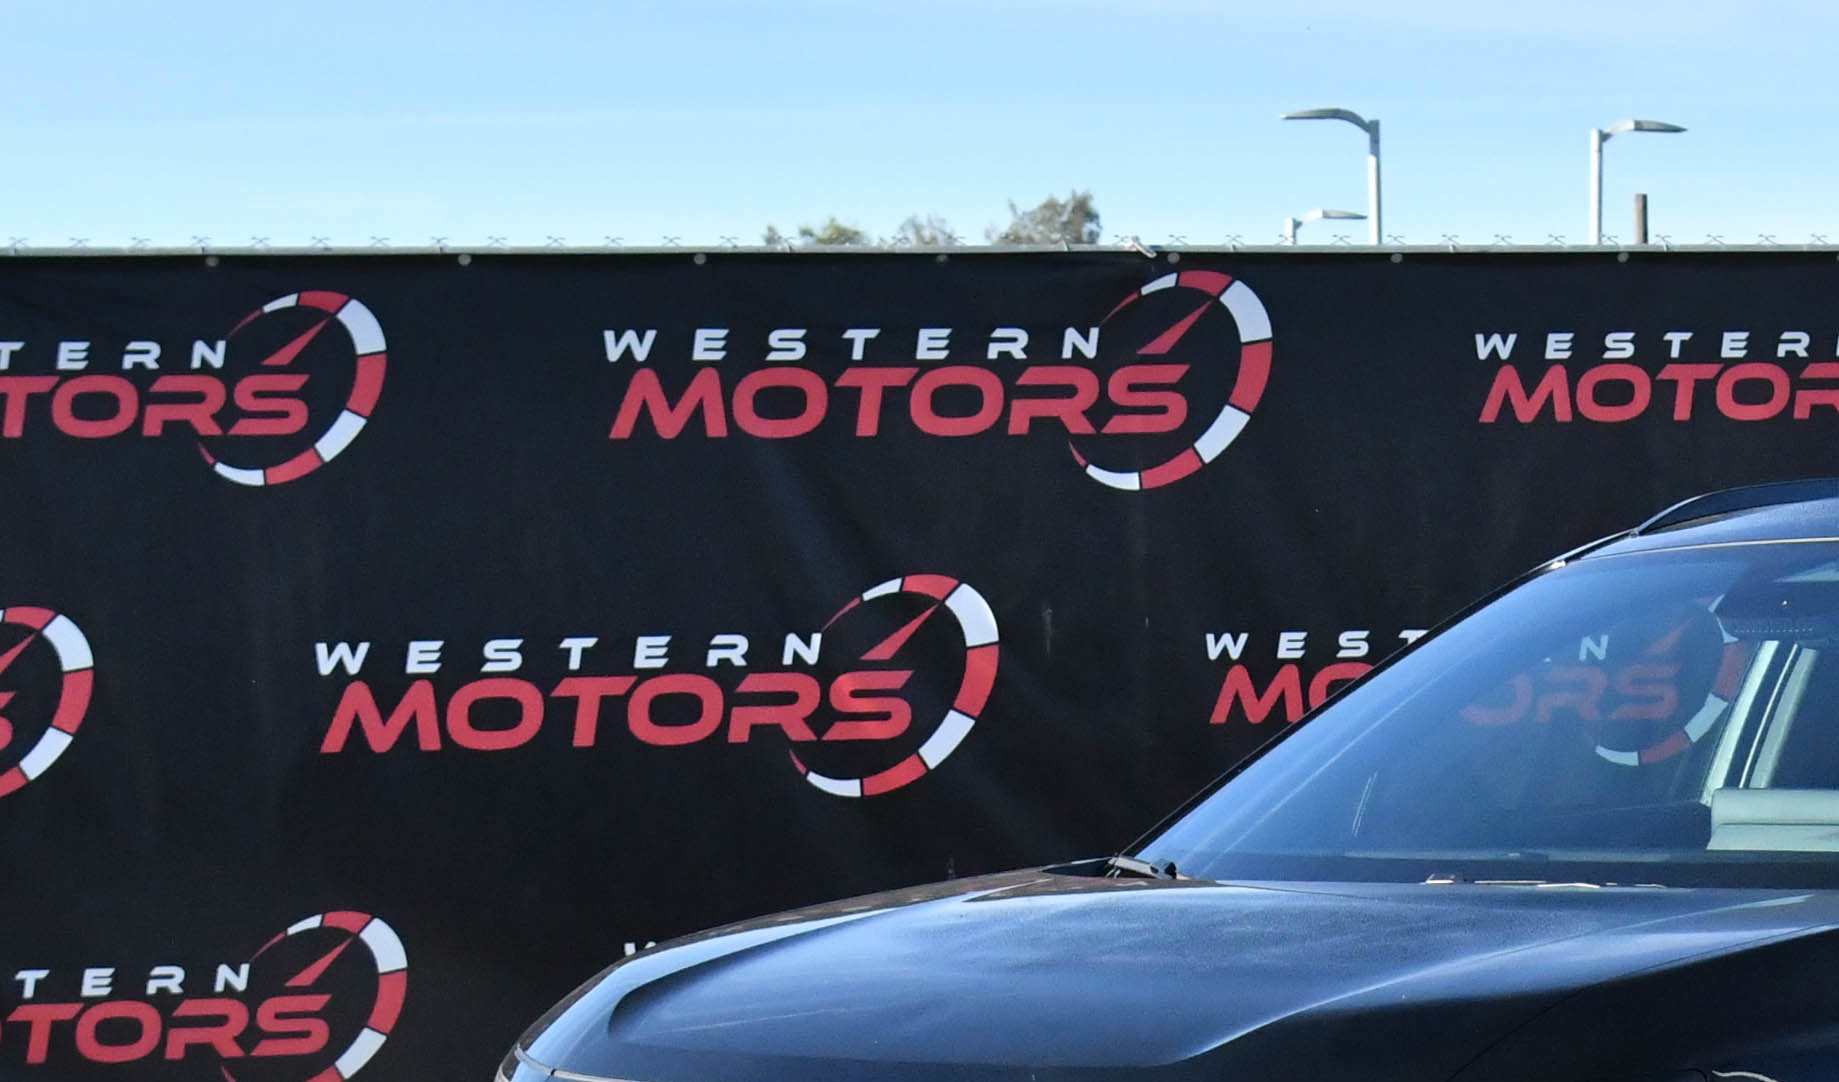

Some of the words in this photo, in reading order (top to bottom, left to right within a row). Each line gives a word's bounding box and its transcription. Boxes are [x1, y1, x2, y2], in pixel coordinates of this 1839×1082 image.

[603, 327, 1099, 362] WESTERN
[609, 364, 1190, 439] MOTORS
[315, 632, 822, 676] WESTERN
[320, 670, 914, 754] MOTORS
